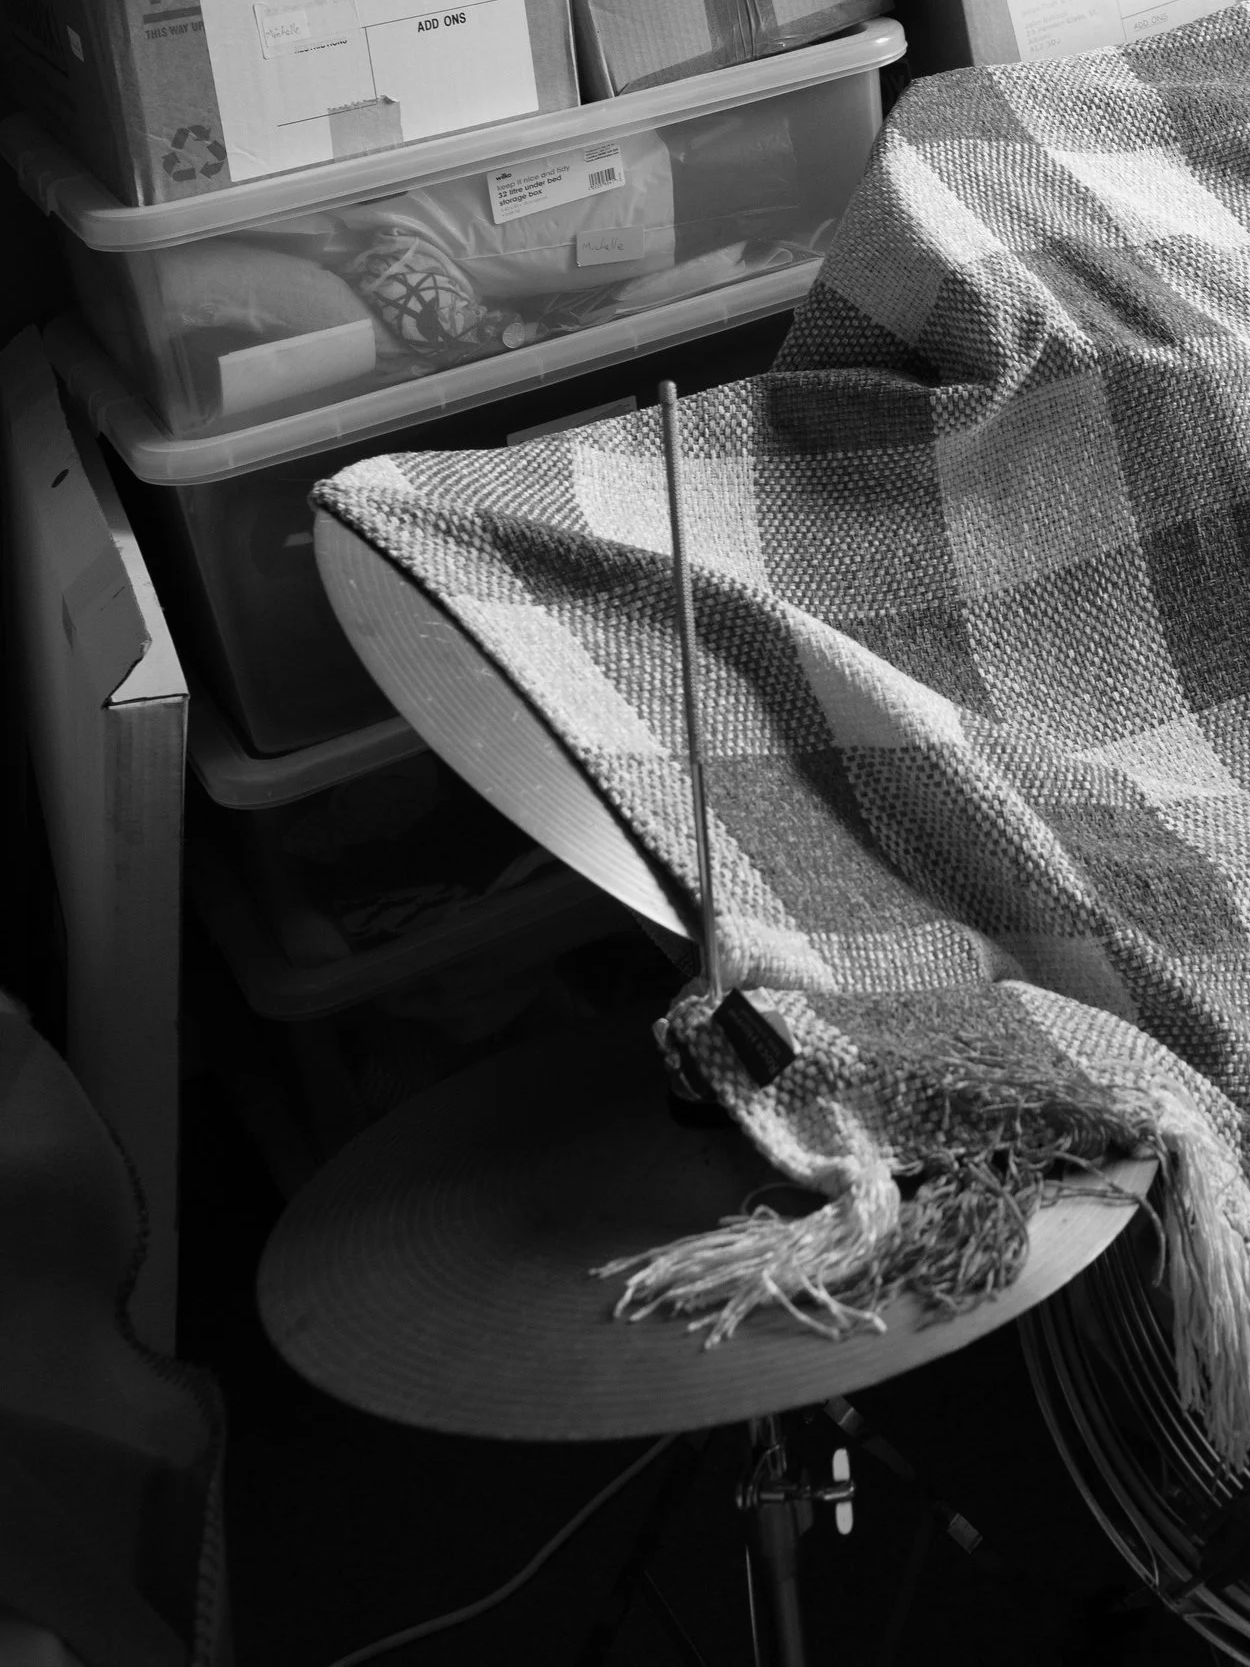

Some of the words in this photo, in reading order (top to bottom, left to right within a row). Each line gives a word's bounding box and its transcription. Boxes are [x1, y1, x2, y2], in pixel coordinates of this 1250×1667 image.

[418, 18, 440, 33] ADD
[444, 12, 467, 27] ONS
[1133, 20, 1149, 31] ADD
[1151, 13, 1168, 23] ONS
[145, 27, 168, 40] THIS
[169, 23, 189, 35] WAY
[495, 172, 513, 182] wilko
[496, 180, 516, 193] keep
[516, 178, 523, 187] it
[523, 173, 539, 184] nice
[540, 168, 555, 179] and
[556, 165, 570, 175] tidy
[498, 190, 508, 199] 32
[509, 185, 523, 196] litre
[524, 180, 545, 192] under
[547, 174, 562, 184] bed
[499, 194, 527, 206] storage
[528, 189, 543, 199] box
[582, 236, 624, 252] Michelle
